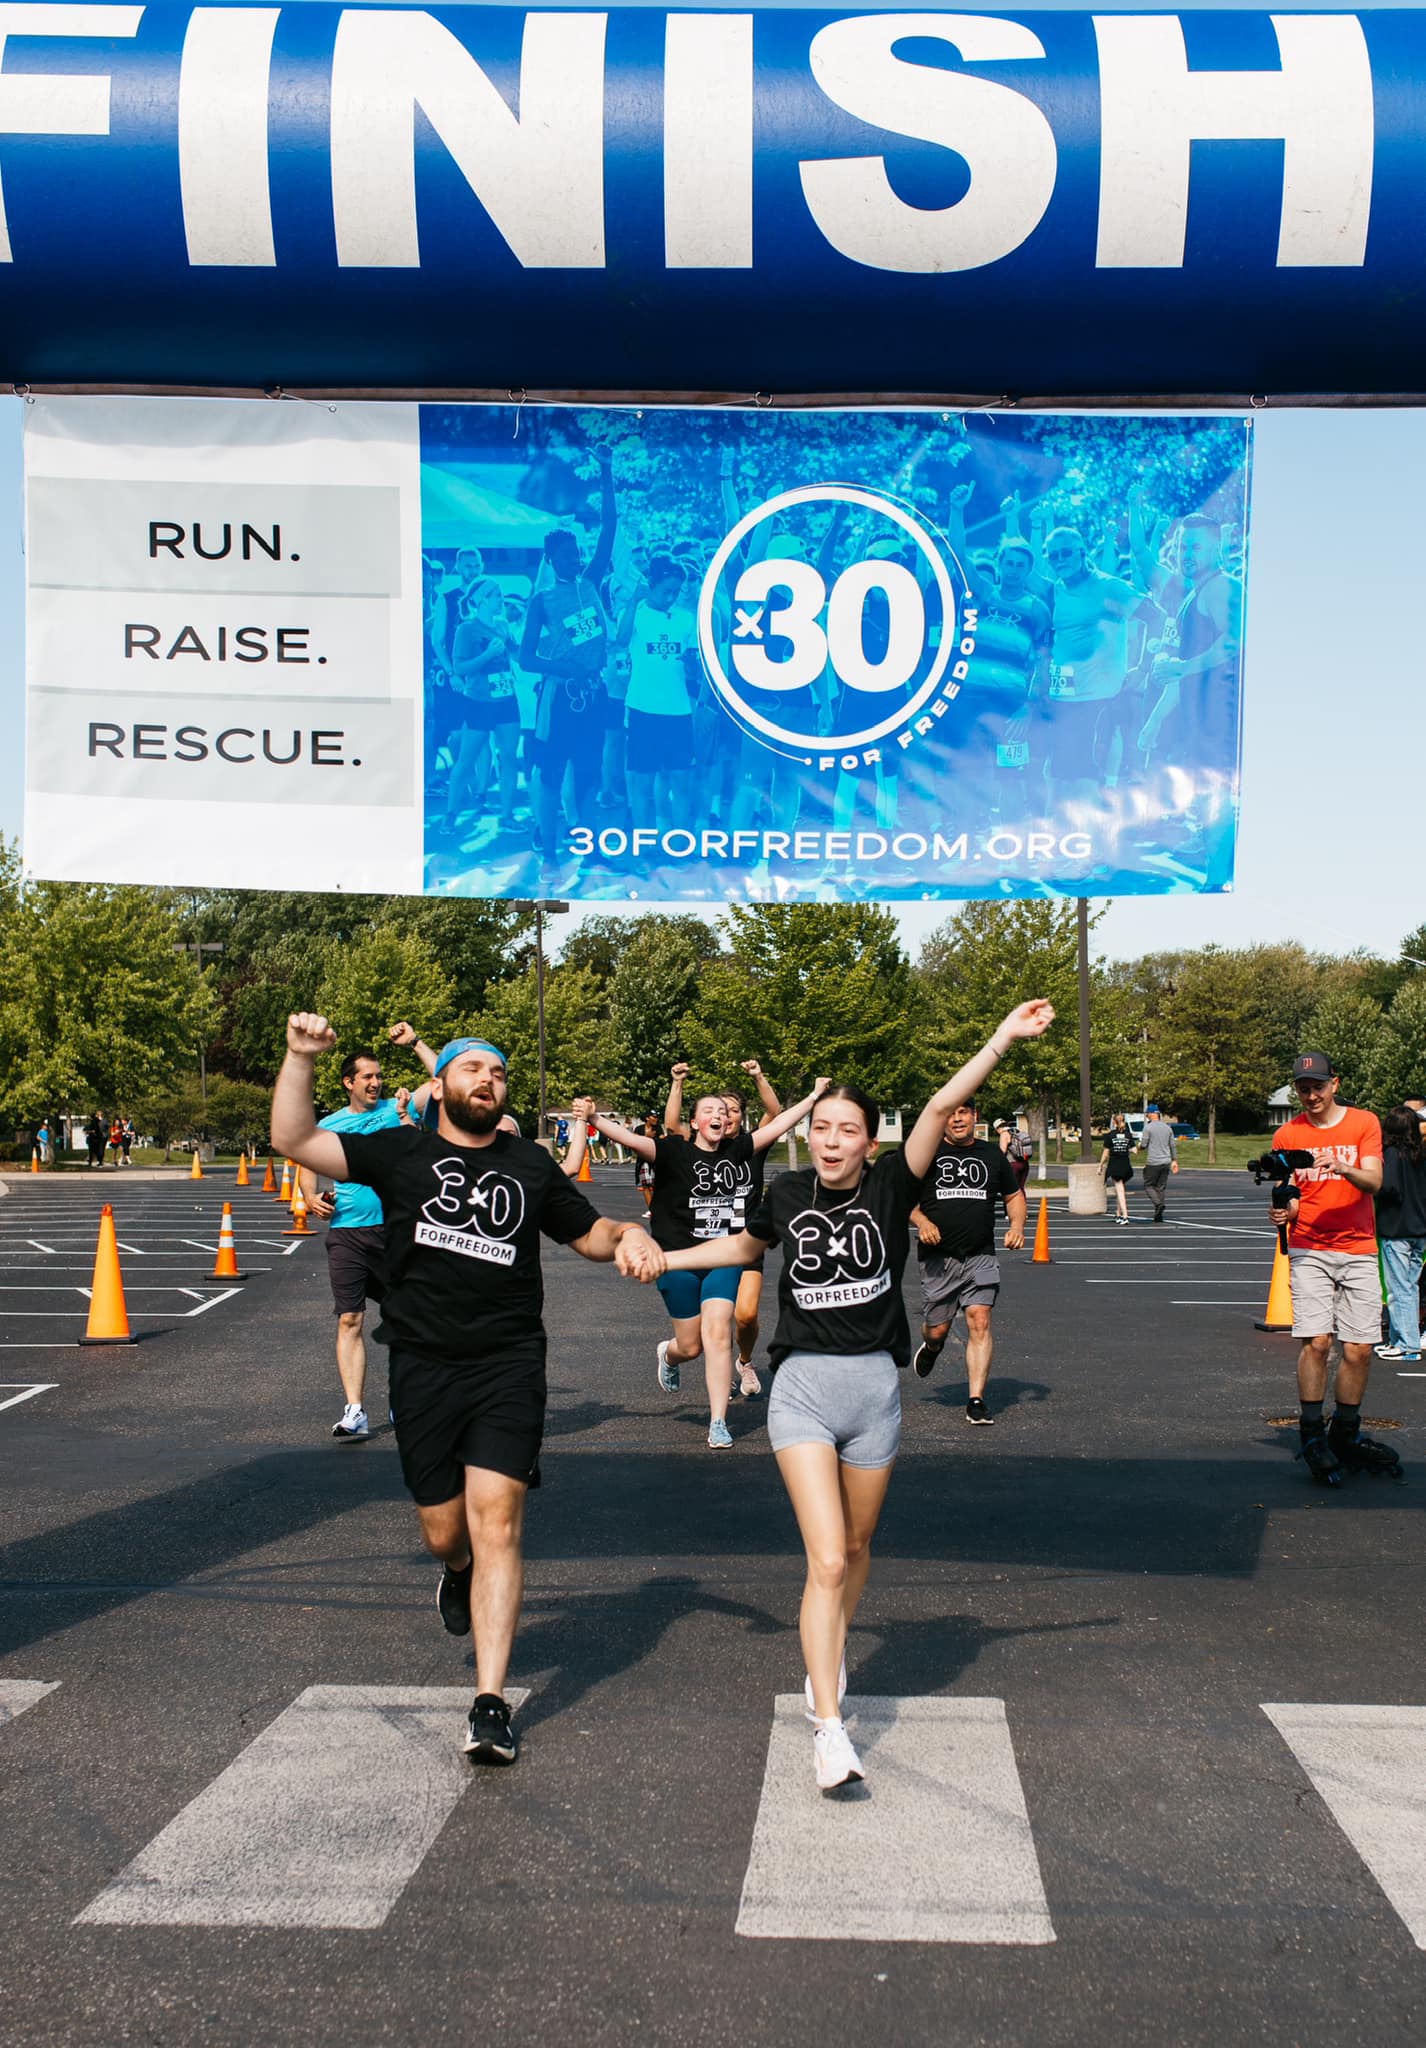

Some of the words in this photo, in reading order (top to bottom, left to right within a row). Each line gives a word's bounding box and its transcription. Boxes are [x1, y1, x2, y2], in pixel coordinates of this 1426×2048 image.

[0, 5, 1374, 273] FINISH
[149, 521, 300, 561] RUN.
[124, 623, 328, 664] RAISE.
[574, 619, 596, 636] 359
[651, 643, 677, 654] 360
[819, 749, 882, 771] FOR
[896, 608, 978, 750] FREEDOM
[88, 722, 362, 767] RESCUE.
[569, 827, 1092, 860] 30FORFREEDOM.ORG
[1335, 1144, 1358, 1154] THE
[704, 1219, 722, 1230] 377
[710, 1209, 720, 1217] 30
[420, 1228, 513, 1260] FORFREEDOM
[797, 1278, 888, 1304] FORFREEDOM
